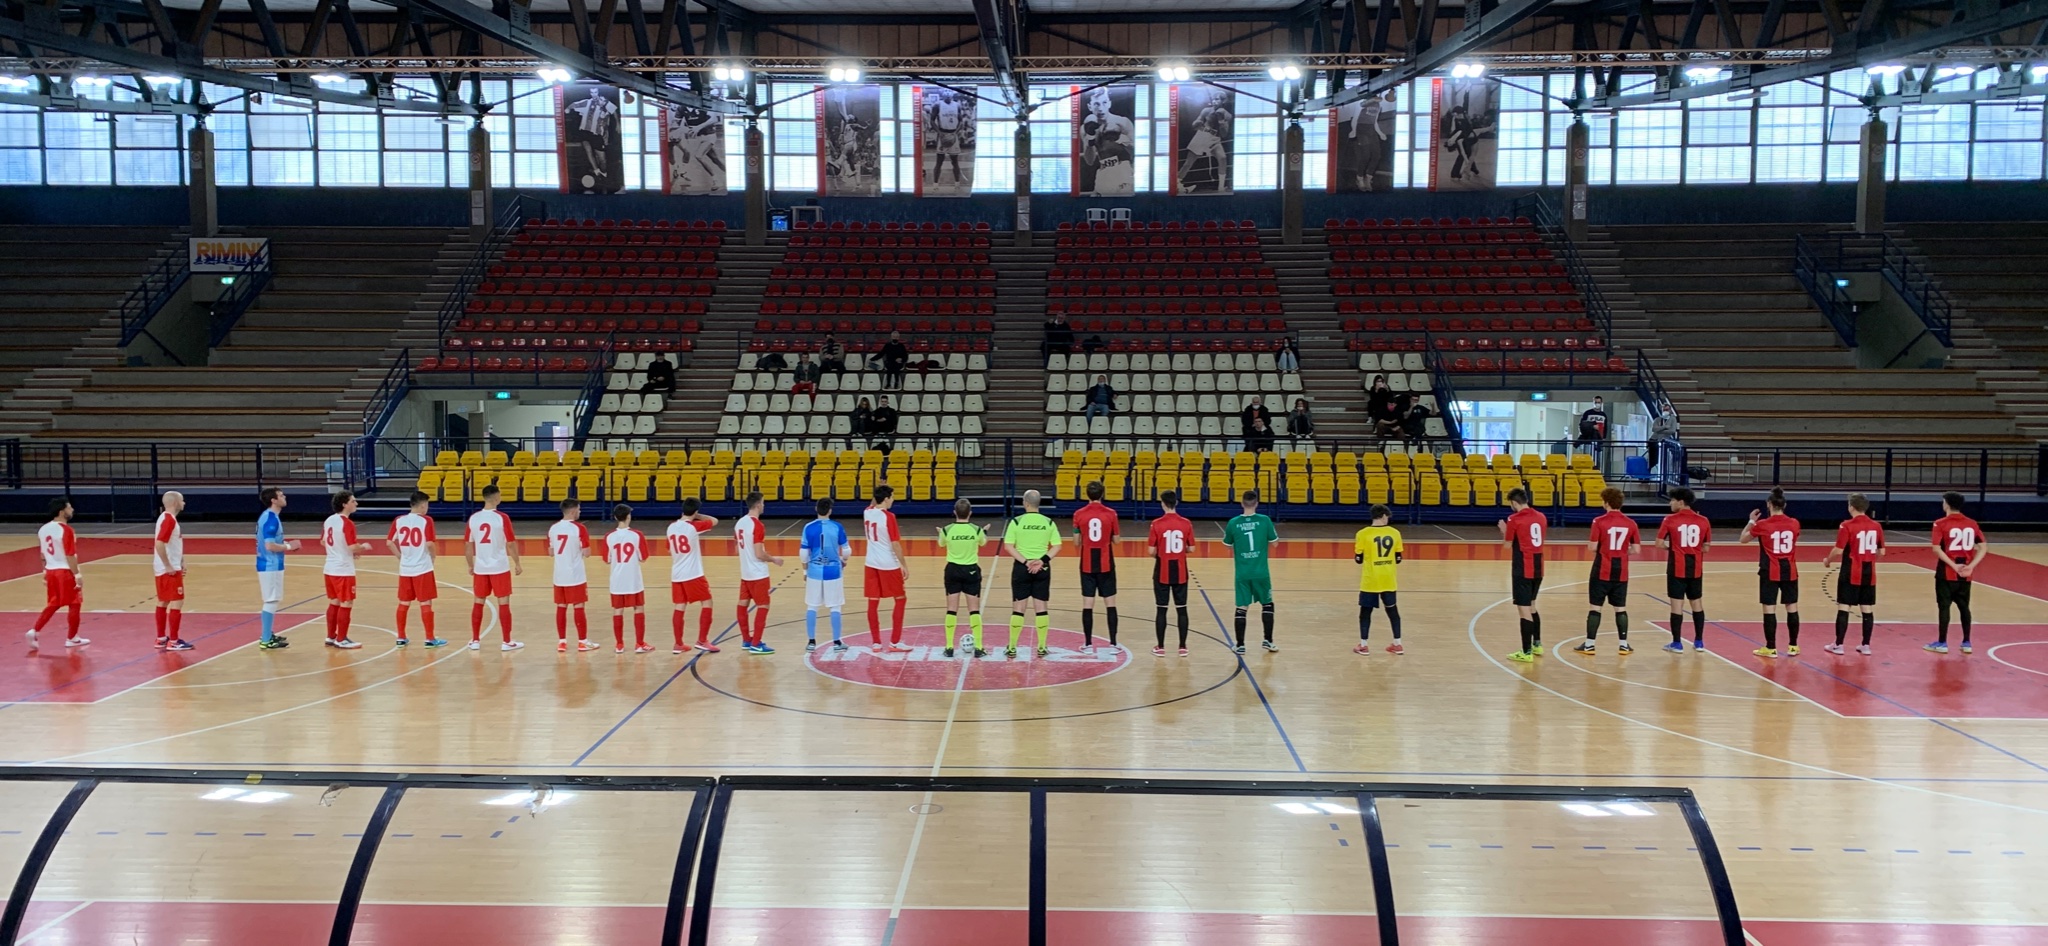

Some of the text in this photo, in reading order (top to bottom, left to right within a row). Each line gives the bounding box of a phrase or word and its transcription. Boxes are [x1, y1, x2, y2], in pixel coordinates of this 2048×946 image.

[658, 112, 666, 126] LUCA
[326, 527, 334, 547] 8
[399, 526, 423, 547] 20
[480, 523, 491, 544] 2
[864, 520, 878, 542] 11
[1088, 518, 1102, 542] 8
[1244, 531, 1254, 551] 1
[1530, 523, 1543, 547] 9
[1607, 527, 1629, 551] 17
[1677, 524, 1701, 548] 18
[1948, 528, 1975, 551] 20
[45, 535, 55, 555] 3
[557, 534, 568, 554] 7
[613, 543, 635, 562] 19
[669, 534, 691, 554] 18
[1163, 530, 1184, 554] 16
[1373, 535, 1394, 557] 19
[1770, 530, 1794, 554] 13
[1856, 530, 1878, 554] 14
